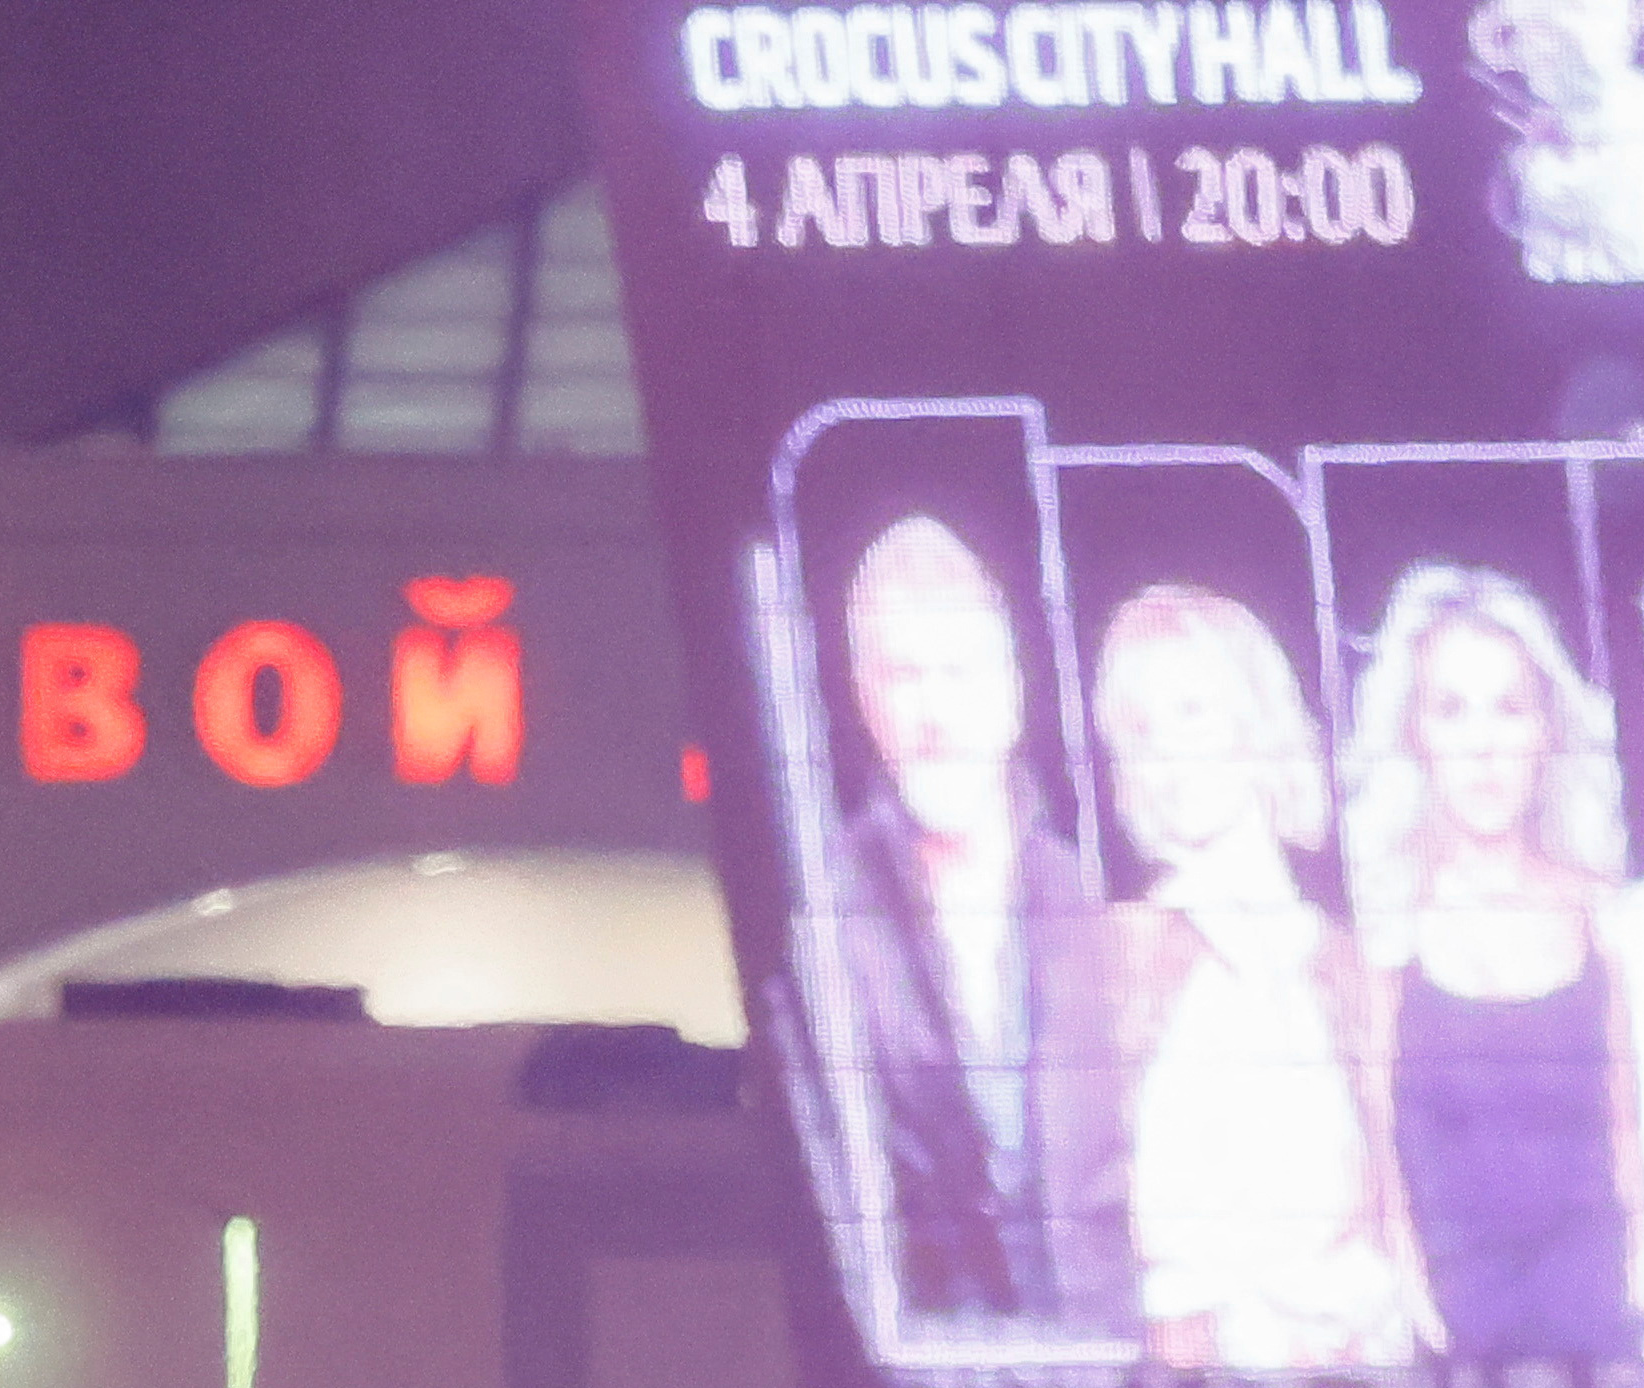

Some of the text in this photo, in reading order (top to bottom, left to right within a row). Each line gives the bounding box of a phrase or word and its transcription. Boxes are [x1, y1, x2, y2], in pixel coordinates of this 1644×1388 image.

[684, 0, 1424, 110] CROCUS CITY HALL
[703, 142, 1417, 248] 4 АПРЕЛЯ 20:00
